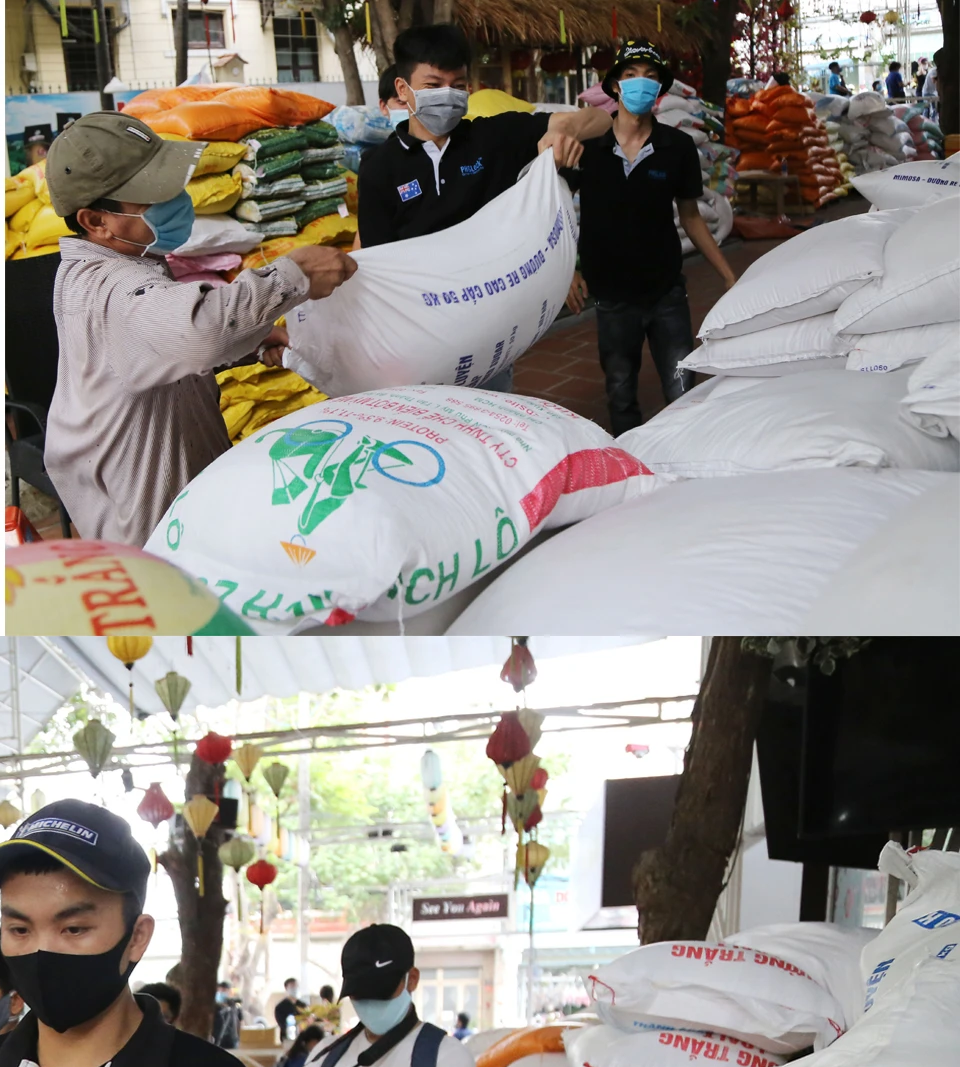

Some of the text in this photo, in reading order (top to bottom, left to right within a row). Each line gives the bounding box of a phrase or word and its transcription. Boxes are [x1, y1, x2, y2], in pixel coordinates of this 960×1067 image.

[893, 174, 921, 182] MIMOSA
[484, 277, 506, 295] CAO
[506, 273, 520, 287] RE
[421, 292, 441, 306] KG
[442, 290, 459, 304] 50
[455, 423, 492, 445] TNHH
[489, 442, 518, 468] CTY
[29, 819, 94, 840] MICHELIN
[419, 899, 500, 917] See You Again
[671, 943, 746, 967] TRẮNG
[658, 1031, 731, 1061] TRẮNG
